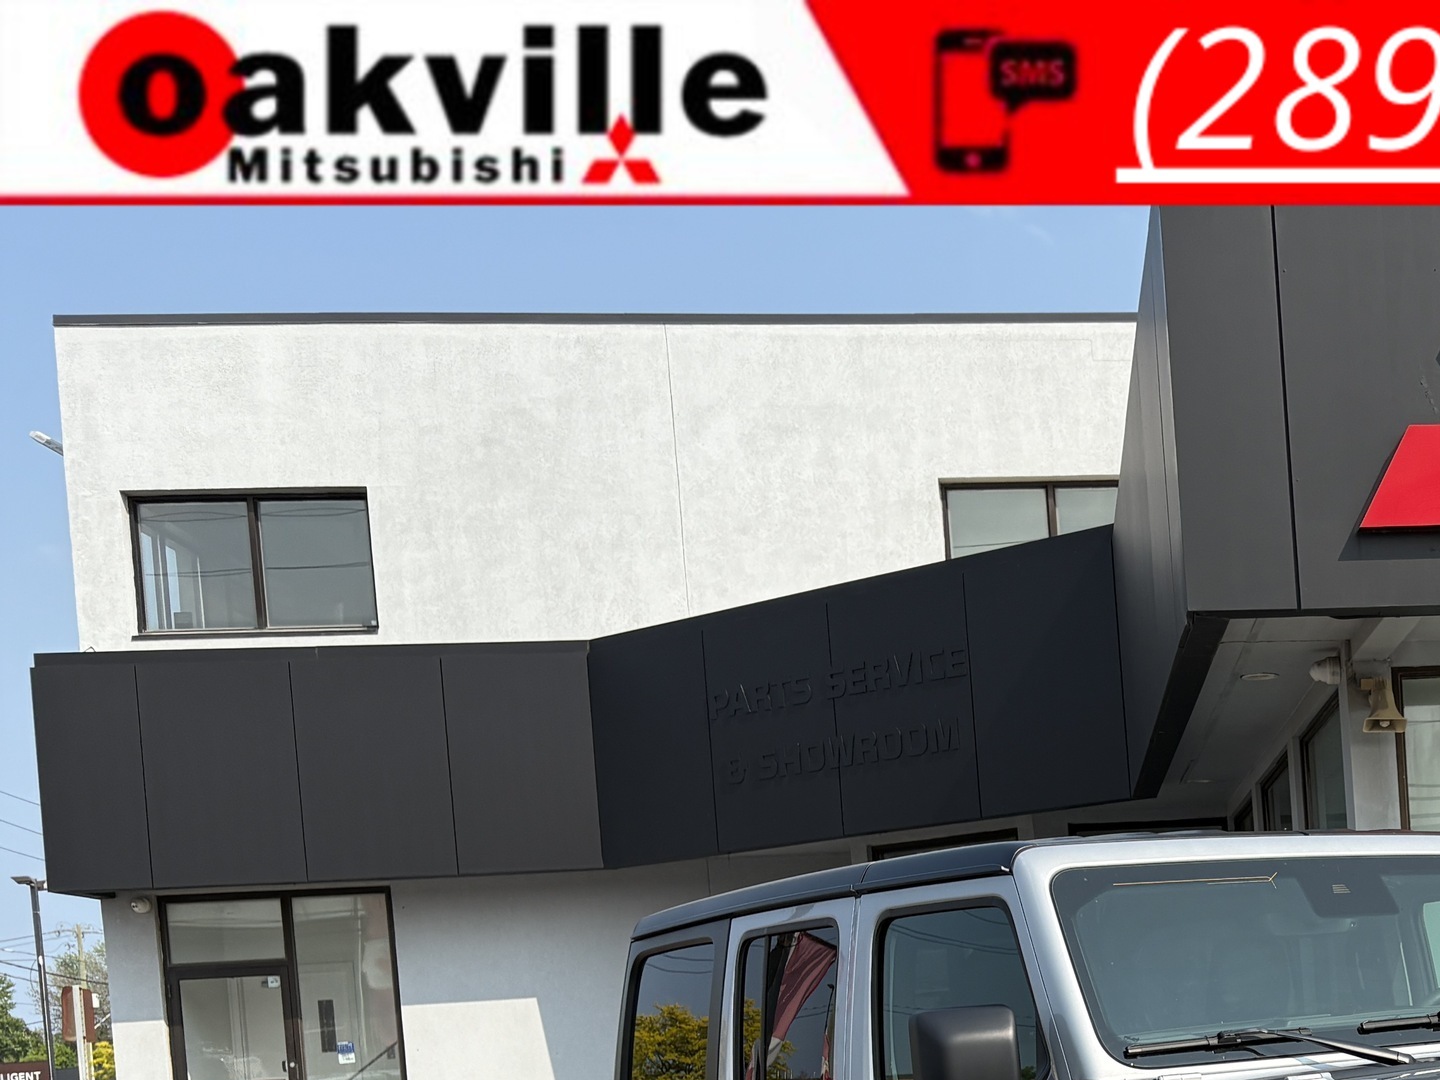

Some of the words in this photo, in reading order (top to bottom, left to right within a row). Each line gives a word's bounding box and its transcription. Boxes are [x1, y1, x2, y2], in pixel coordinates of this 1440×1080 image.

[711, 677, 813, 720] PARTS
[826, 648, 969, 701] SERVICE
[757, 717, 961, 781] SHOWROOM
